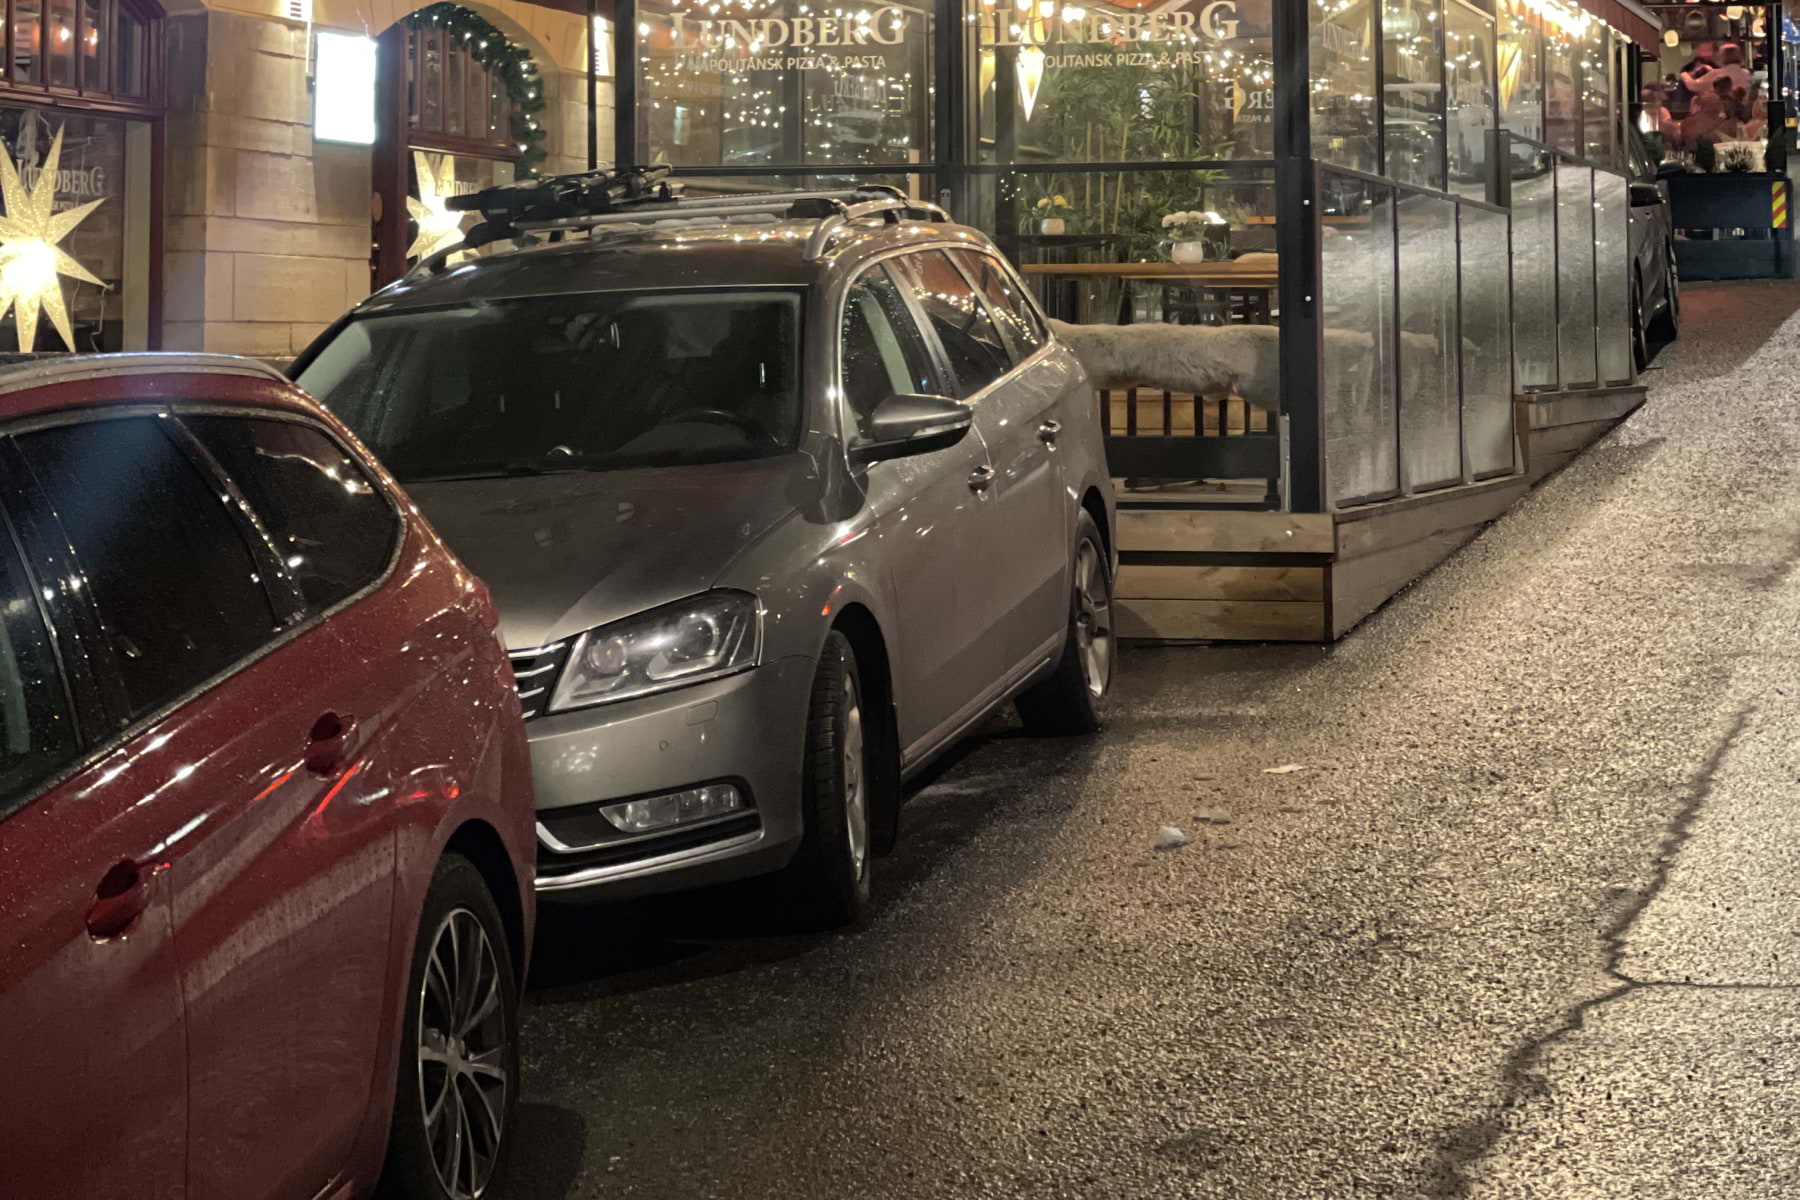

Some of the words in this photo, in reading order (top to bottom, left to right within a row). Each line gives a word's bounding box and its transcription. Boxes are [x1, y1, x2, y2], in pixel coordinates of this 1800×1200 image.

[669, 5, 910, 49] LUNDBERG
[995, 1, 1239, 46] LUNDBERG
[687, 57, 784, 73] NAPOLITANSK
[787, 56, 826, 70] PIZZA
[829, 55, 840, 69] &
[844, 55, 886, 69] PASTA
[1016, 53, 1113, 68] OLITANSK
[1116, 52, 1154, 66] PIZZA
[1160, 52, 1171, 65] &
[1175, 50, 1218, 65] PAST
